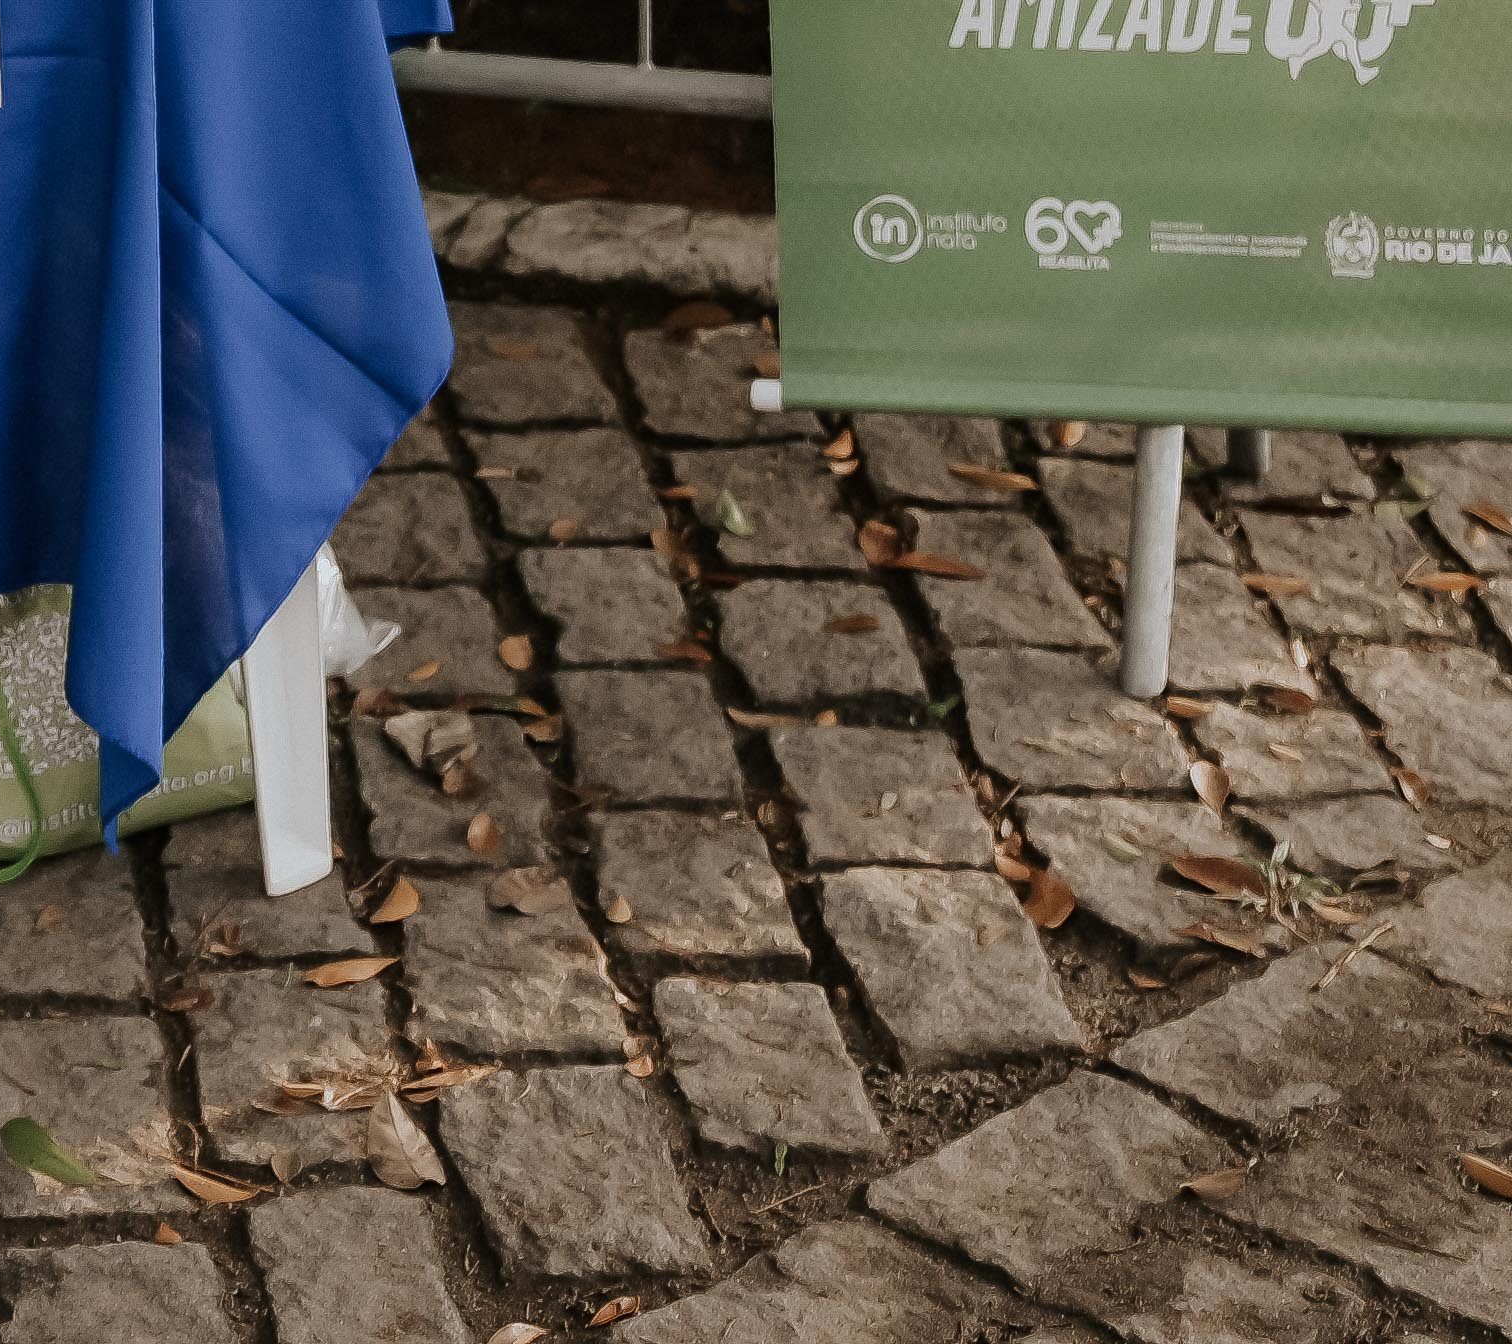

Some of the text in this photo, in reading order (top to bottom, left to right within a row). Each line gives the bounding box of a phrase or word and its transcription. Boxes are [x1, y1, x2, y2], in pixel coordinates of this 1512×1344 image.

[926, 211, 1009, 234] instituto
[926, 232, 978, 250] nata
[1383, 225, 1475, 242] GOVERNO
[1483, 228, 1511, 244] DO
[1384, 240, 1434, 263] RIO
[1437, 241, 1474, 265] DE
[1037, 255, 1112, 272] REABILITA
